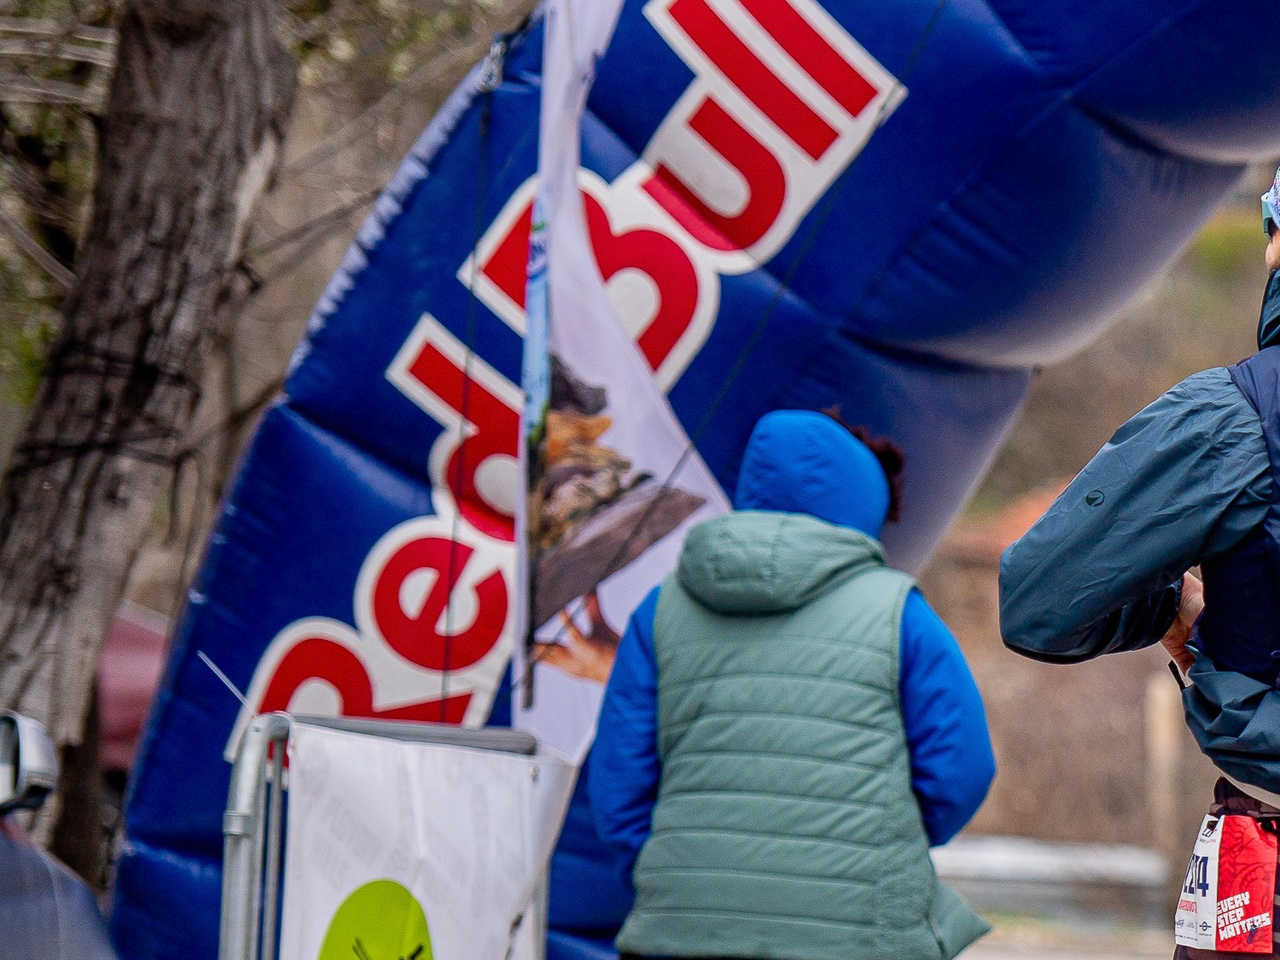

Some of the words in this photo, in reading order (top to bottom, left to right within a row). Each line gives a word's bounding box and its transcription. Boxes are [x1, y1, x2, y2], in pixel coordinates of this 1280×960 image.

[250, 335, 523, 727] Red
[475, 0, 888, 380] Bull
[1216, 891, 1250, 915] EVERY
[1217, 907, 1245, 928] STEP
[1218, 912, 1271, 941] MATTERS
